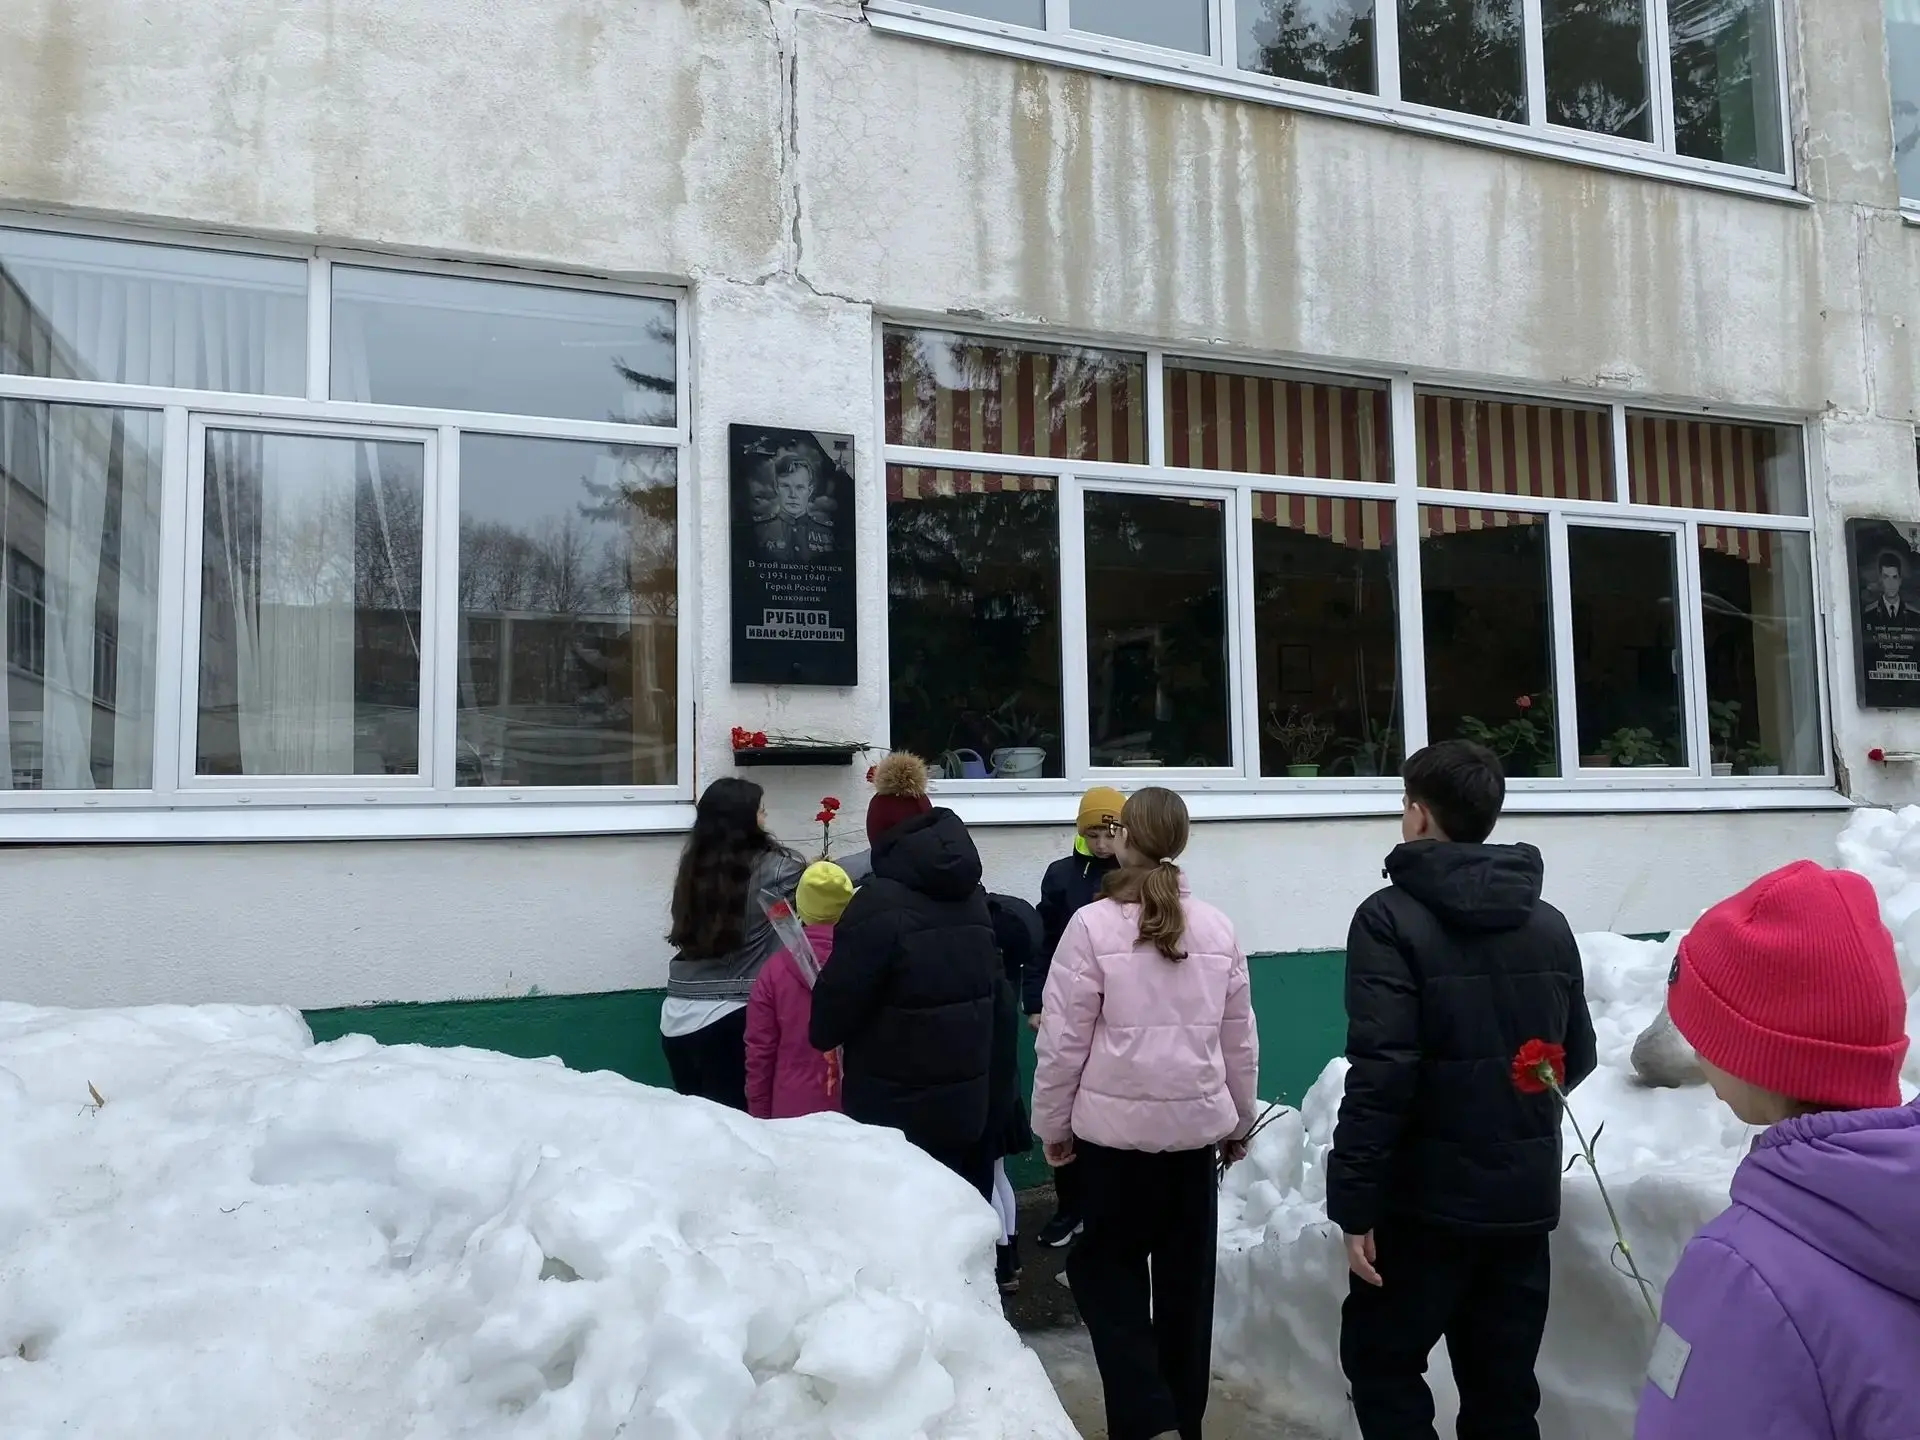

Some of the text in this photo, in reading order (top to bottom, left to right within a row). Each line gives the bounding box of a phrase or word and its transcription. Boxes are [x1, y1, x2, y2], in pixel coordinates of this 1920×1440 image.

[748, 560, 842, 572] В этой школе учился
[805, 573, 825, 582] 1940
[765, 582, 827, 592] Герой России
[772, 594, 821, 602] полковник
[766, 611, 827, 626] РУБЦОВ
[748, 627, 843, 640] ИВАН ФЁДОРОВИЧ
